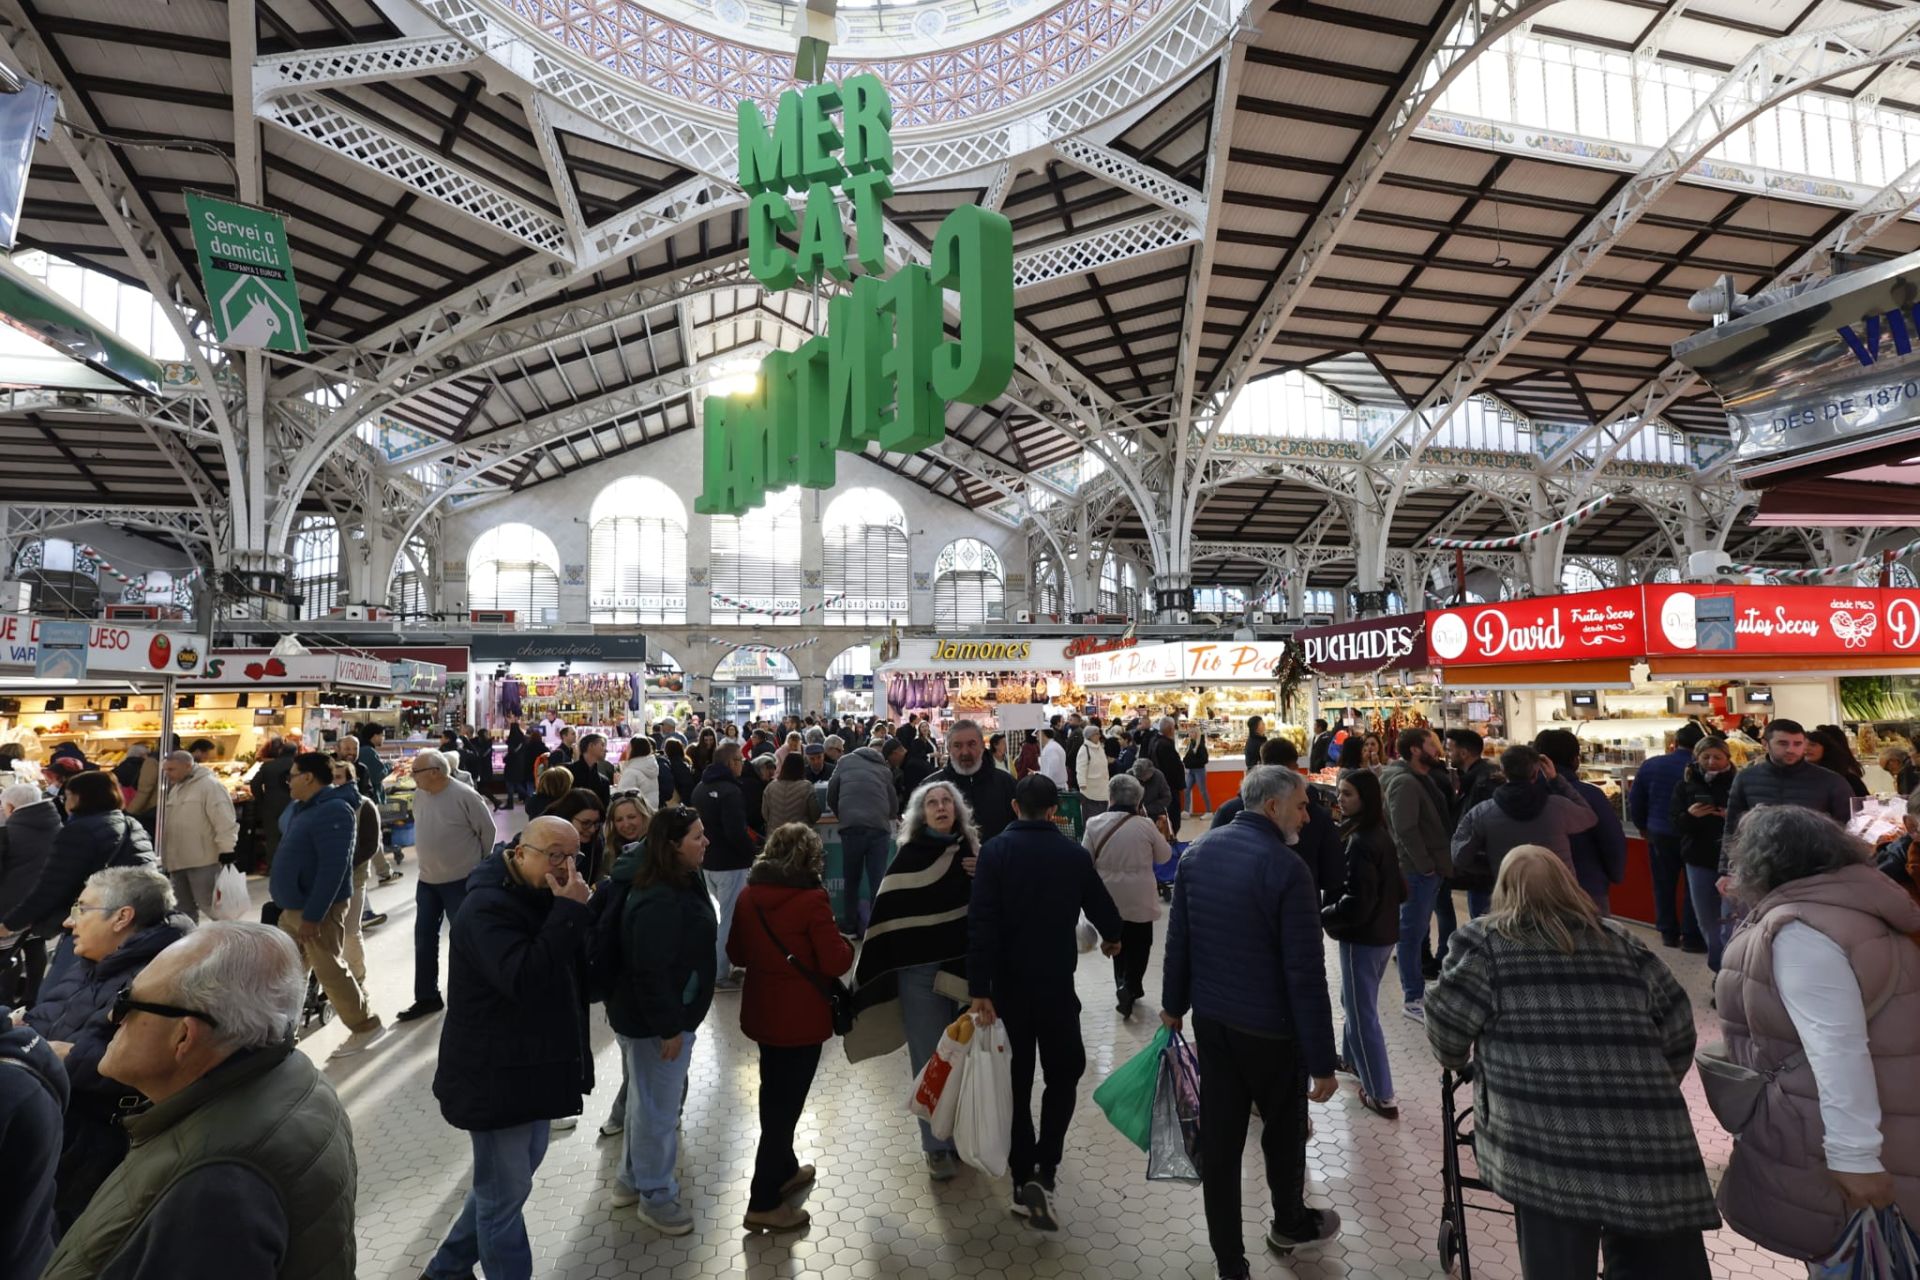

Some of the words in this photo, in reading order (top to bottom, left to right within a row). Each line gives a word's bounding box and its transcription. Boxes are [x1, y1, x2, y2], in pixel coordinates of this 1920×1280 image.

[738, 73, 893, 196] MER
[204, 211, 260, 242] Servei
[264, 231, 275, 245] a
[748, 170, 894, 291] CAT
[210, 235, 280, 266] domicili
[228, 262, 254, 275] ESPANYA
[260, 268, 282, 279] EUROPA
[1773, 408, 1817, 433] DES
[1823, 397, 1855, 420] DE
[1864, 381, 1919, 408] 1870
[1570, 608, 1605, 624] Frutos
[1605, 605, 1635, 621] Secos
[1775, 605, 1820, 637] Secos
[1304, 626, 1413, 664] PUCHADES
[1473, 608, 1565, 657] David
[931, 639, 1031, 661] Jamones
[1081, 658, 1101, 671] fruits
[339, 659, 379, 684] VIRGINIA
